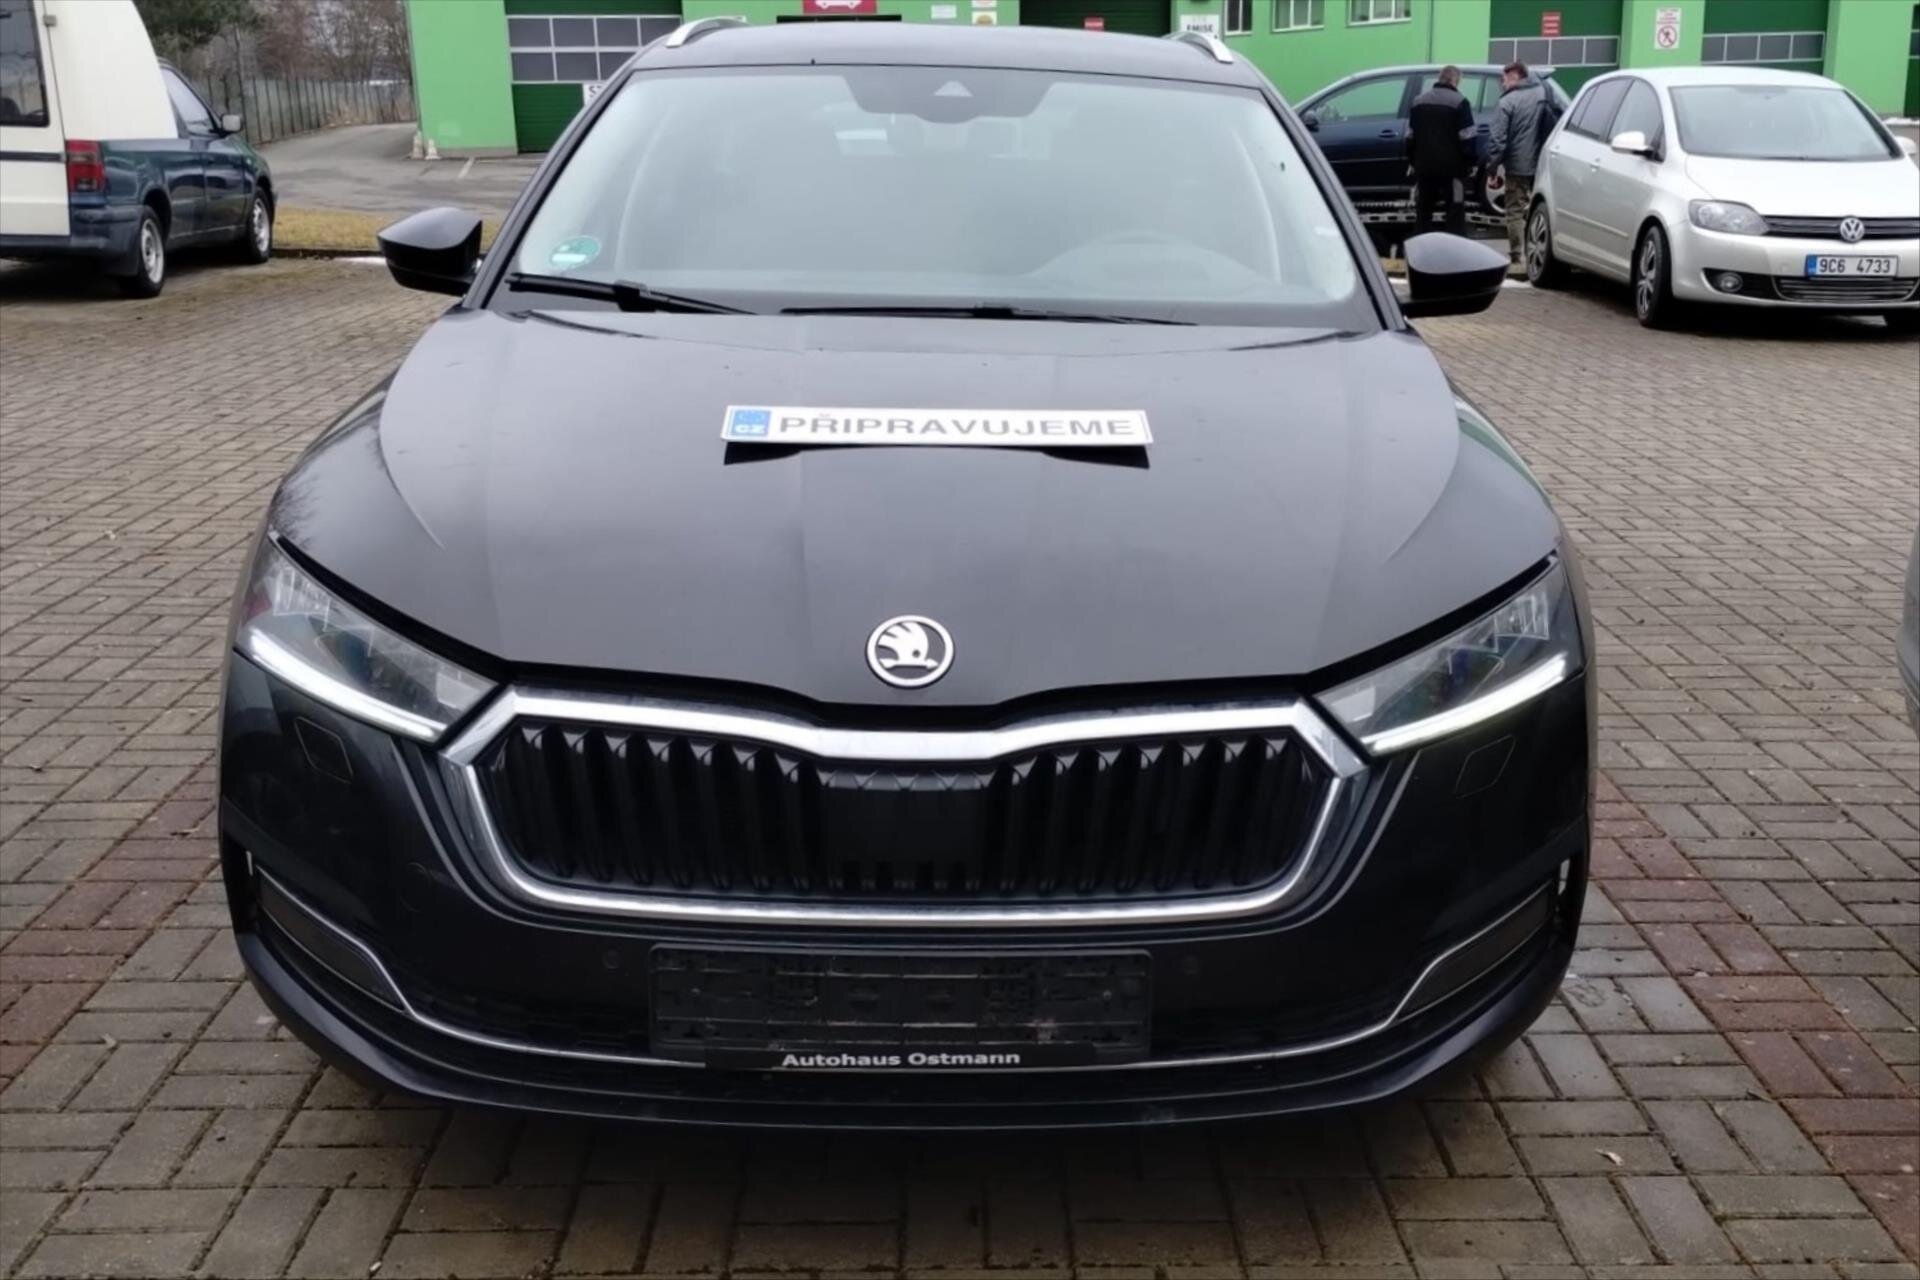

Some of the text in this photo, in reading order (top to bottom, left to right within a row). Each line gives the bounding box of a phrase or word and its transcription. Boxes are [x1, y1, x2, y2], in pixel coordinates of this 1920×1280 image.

[1820, 259, 1845, 273] 9C6
[1857, 259, 1890, 273] 4733
[734, 408, 1134, 435] CZ PŘIPRAVUJEME
[782, 1052, 1020, 1067] Autohaus Ostmann
